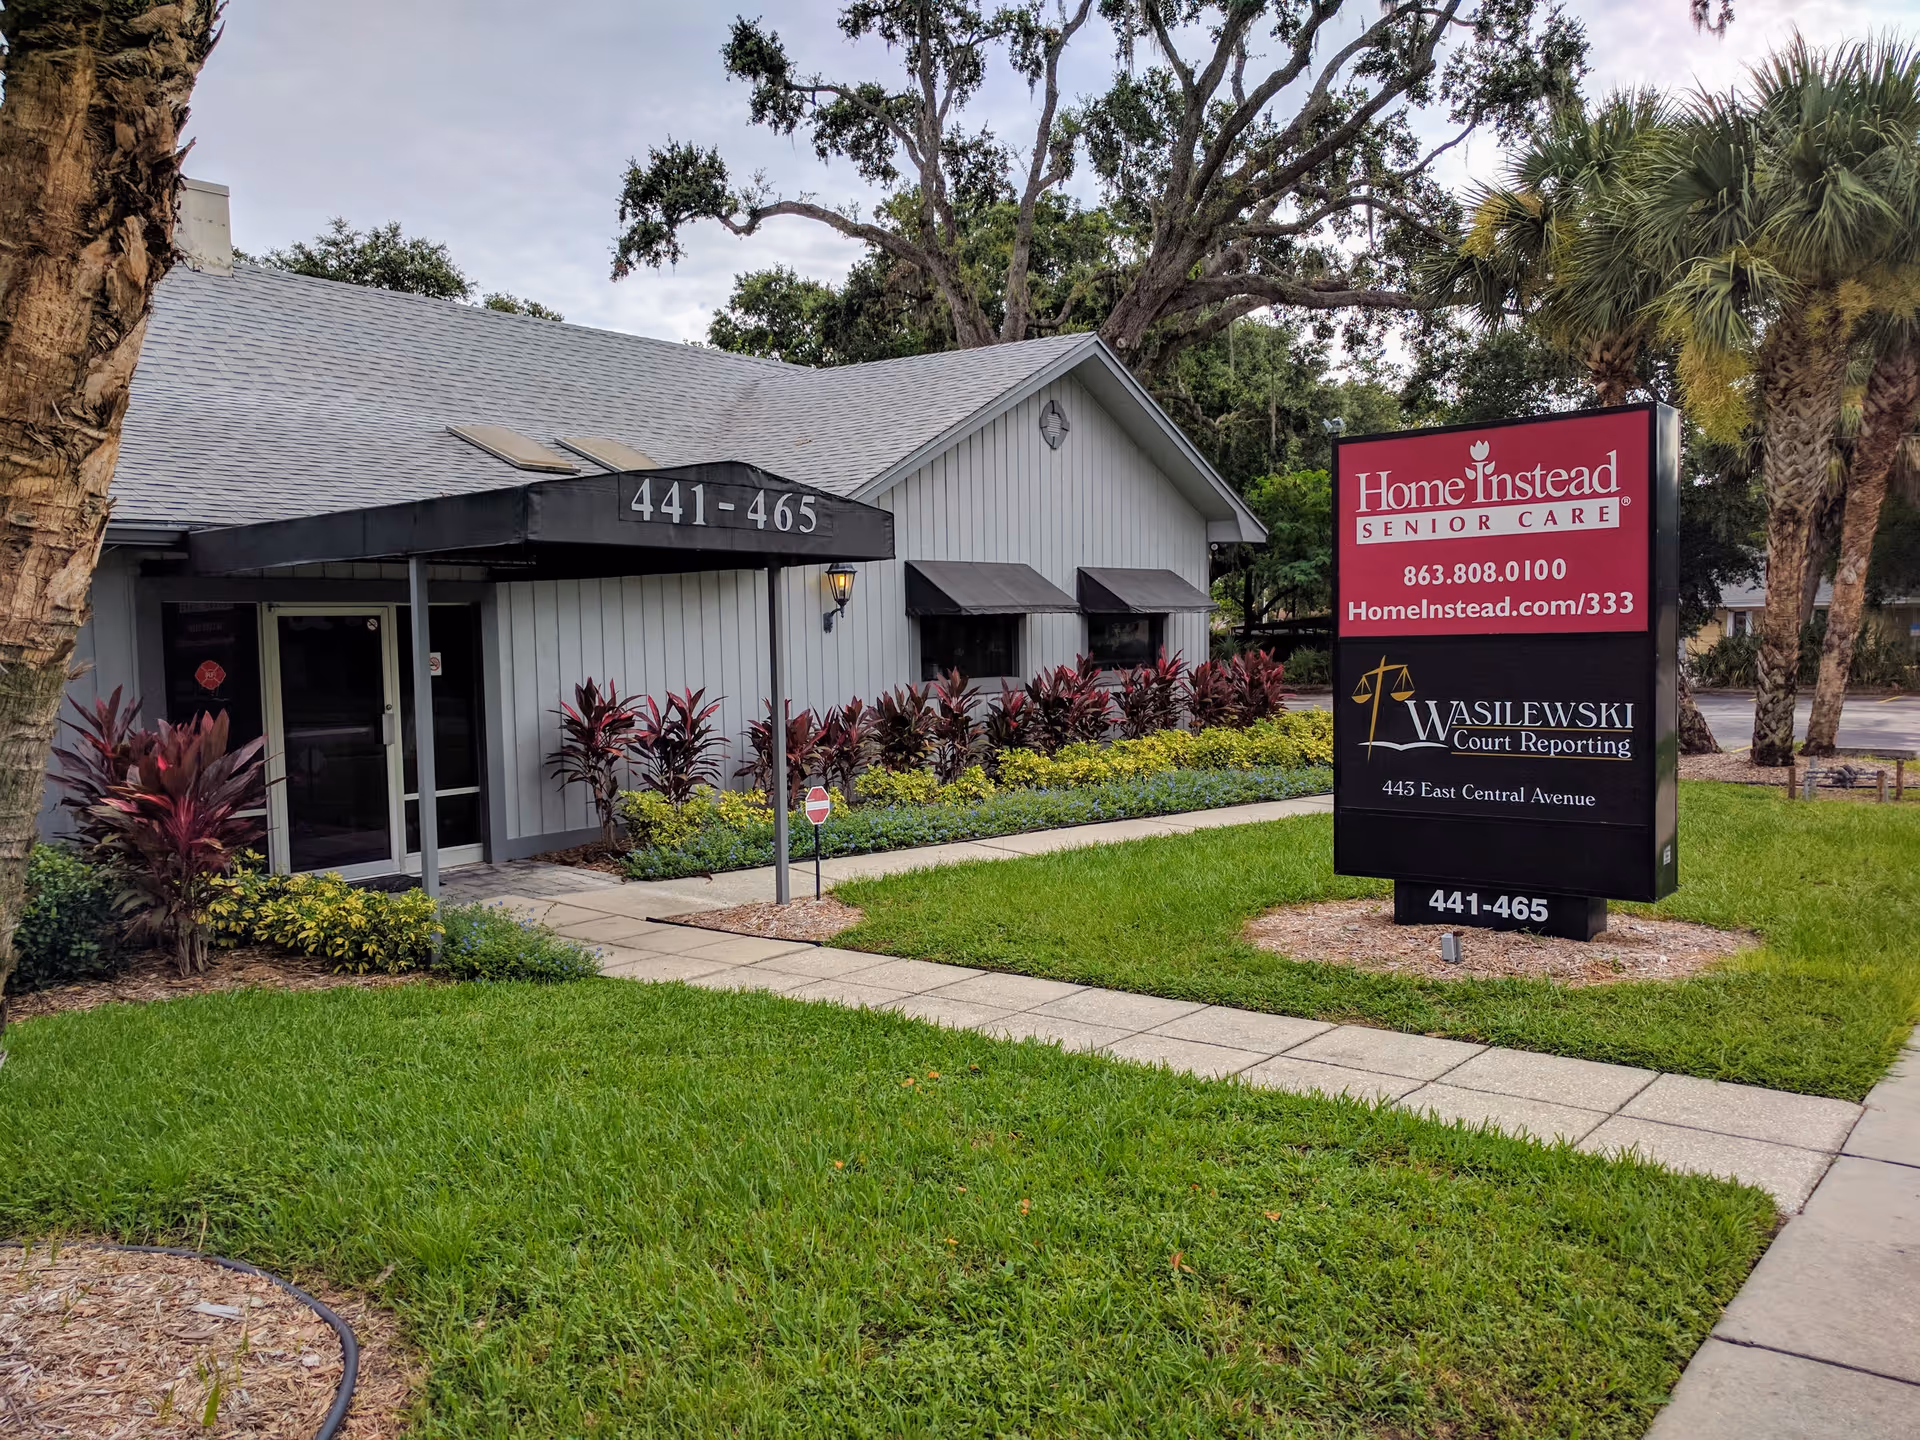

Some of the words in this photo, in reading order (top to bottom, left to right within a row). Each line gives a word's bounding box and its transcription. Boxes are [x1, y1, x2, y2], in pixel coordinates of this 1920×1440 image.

[1355, 470, 1465, 512] Home
[1471, 450, 1621, 503] Instead
[1362, 514, 1491, 538] SENIOR
[1518, 506, 1609, 528] CARE
[1403, 558, 1567, 586] 863.808.0100
[1348, 592, 1634, 621] HomeInstead.com/333
[1405, 700, 1634, 741] WASILEWSKI
[1453, 730, 1511, 751] Court
[1520, 731, 1632, 759] Reporting
[1382, 780, 1415, 797] 443
[1421, 782, 1456, 800] East
[1462, 784, 1525, 803] Central
[1531, 789, 1596, 807] Avenue
[1428, 889, 1549, 922] 441-465
